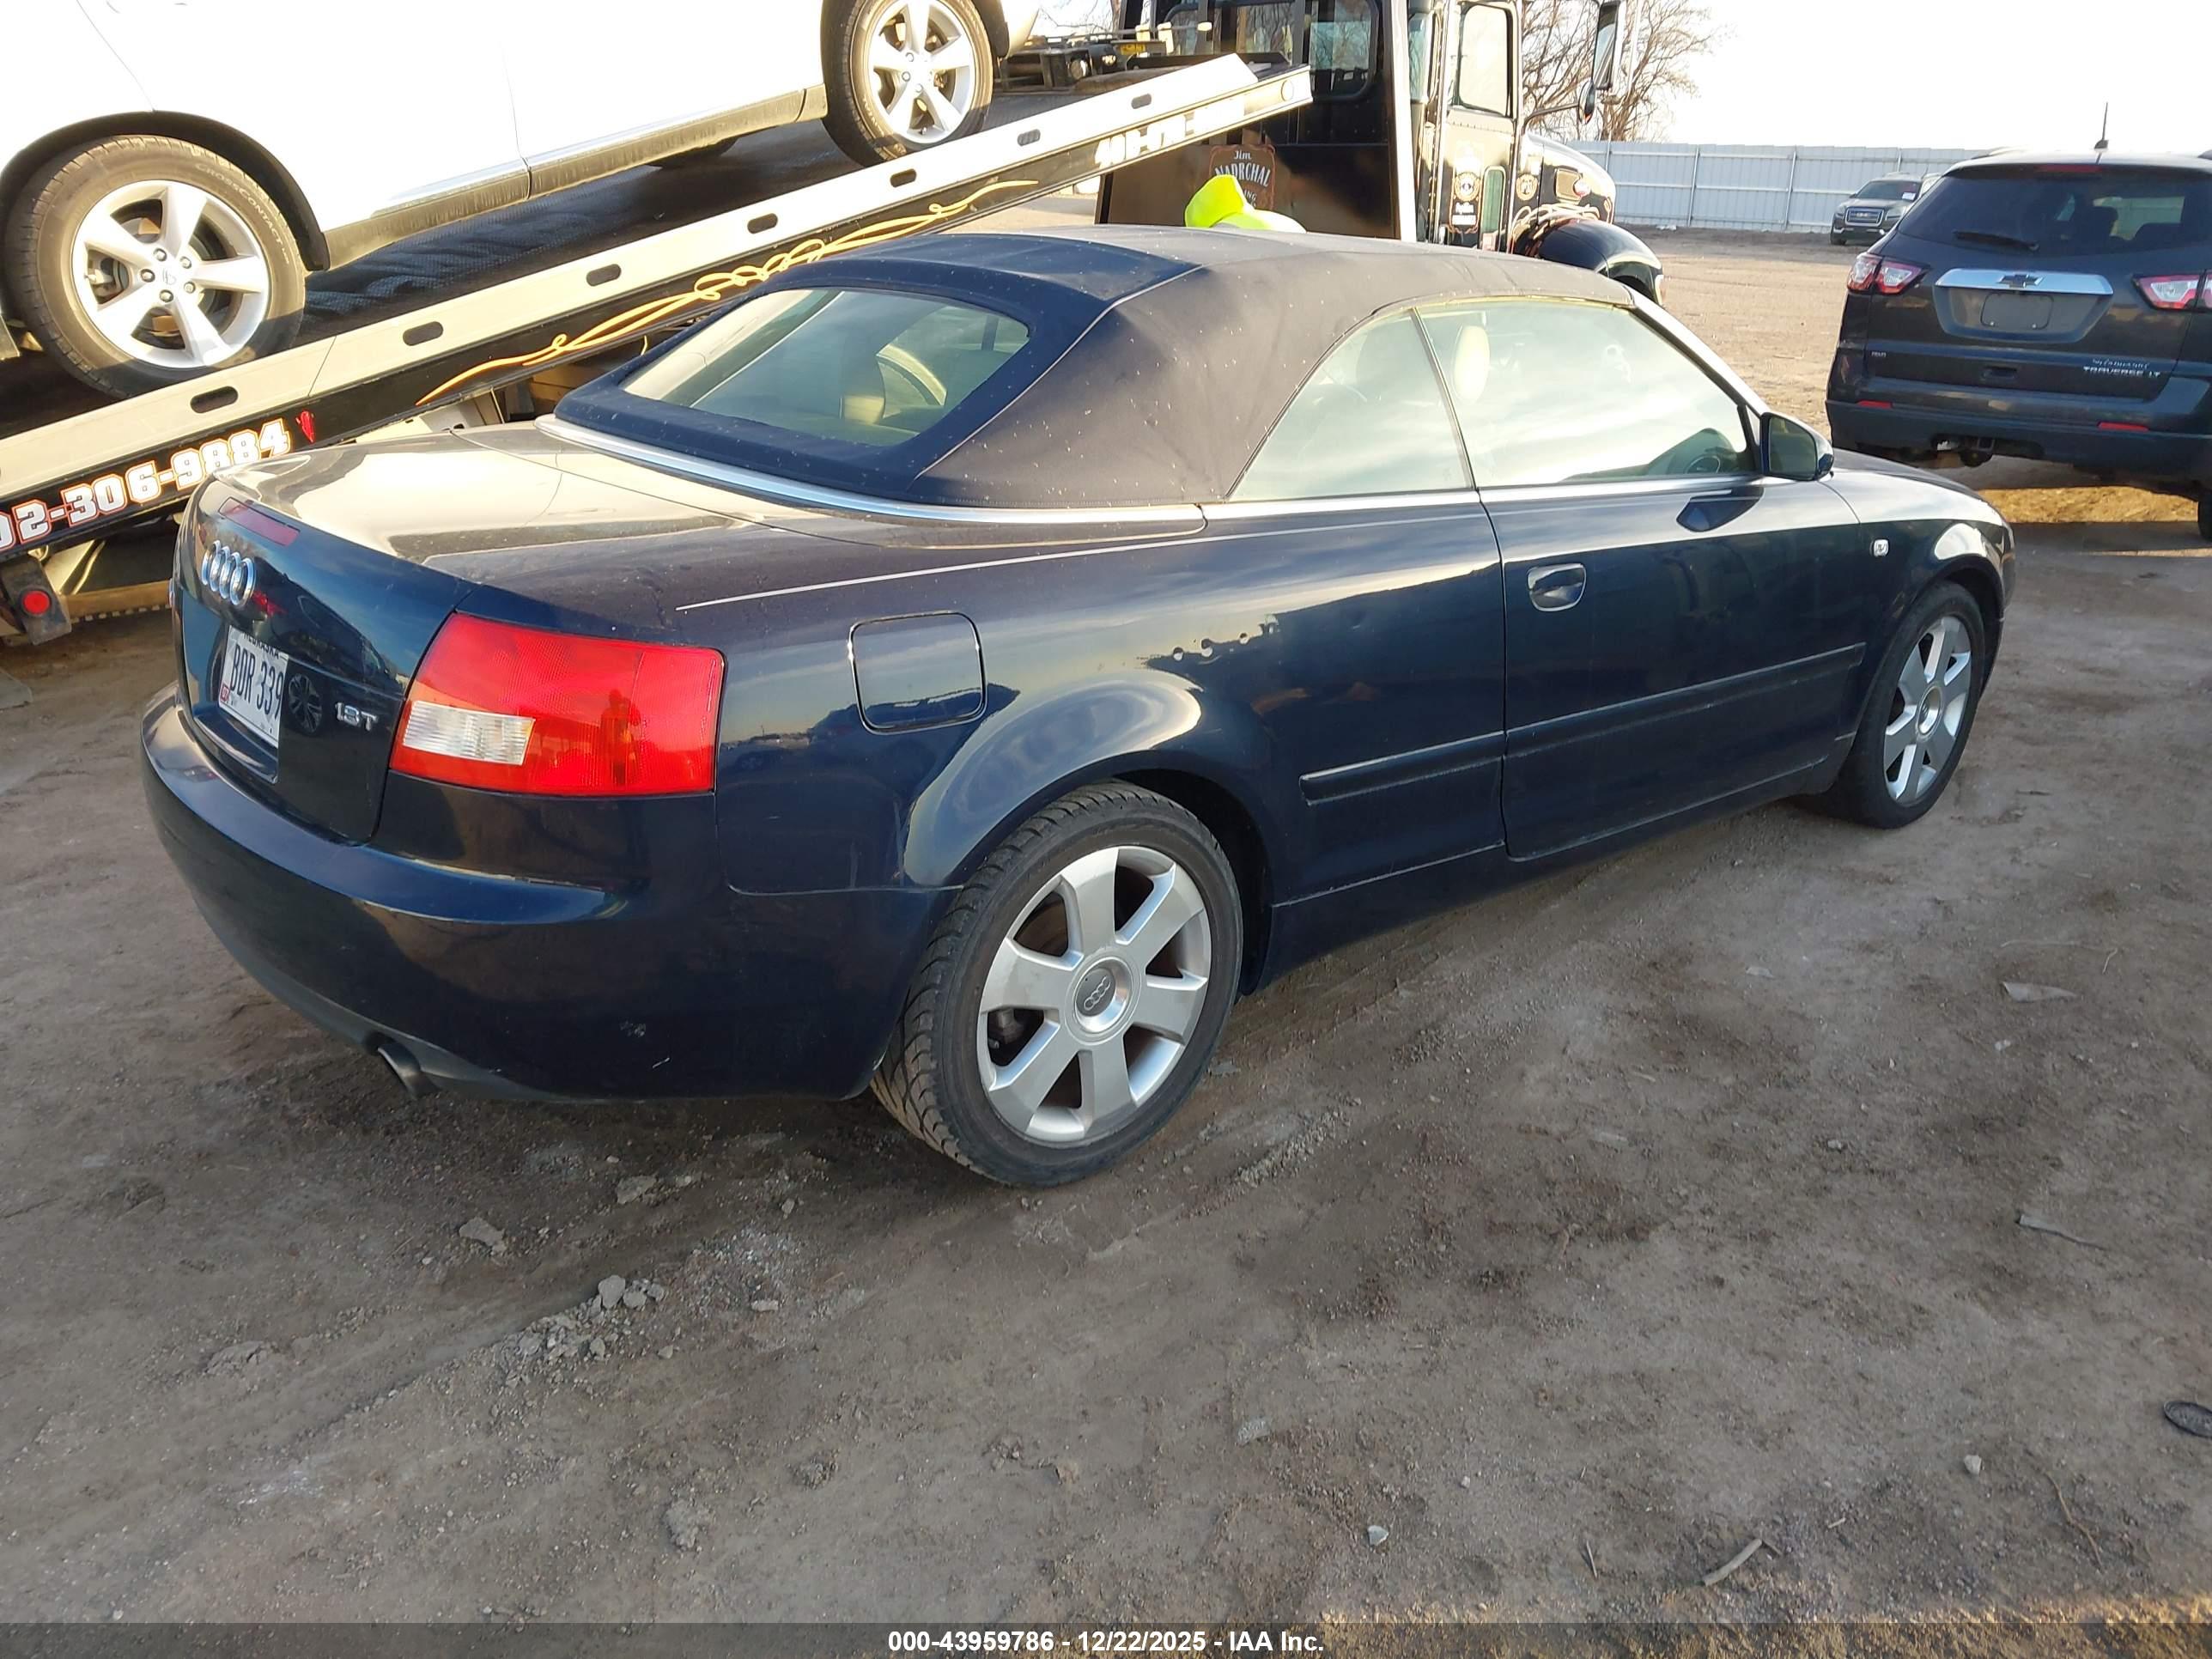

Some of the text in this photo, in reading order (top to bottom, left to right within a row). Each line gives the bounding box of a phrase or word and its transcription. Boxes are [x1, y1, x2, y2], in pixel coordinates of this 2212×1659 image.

[1233, 149, 1252, 161] Jim
[2083, 366, 2144, 376] TRAVERSE
[256, 660, 284, 720] 339
